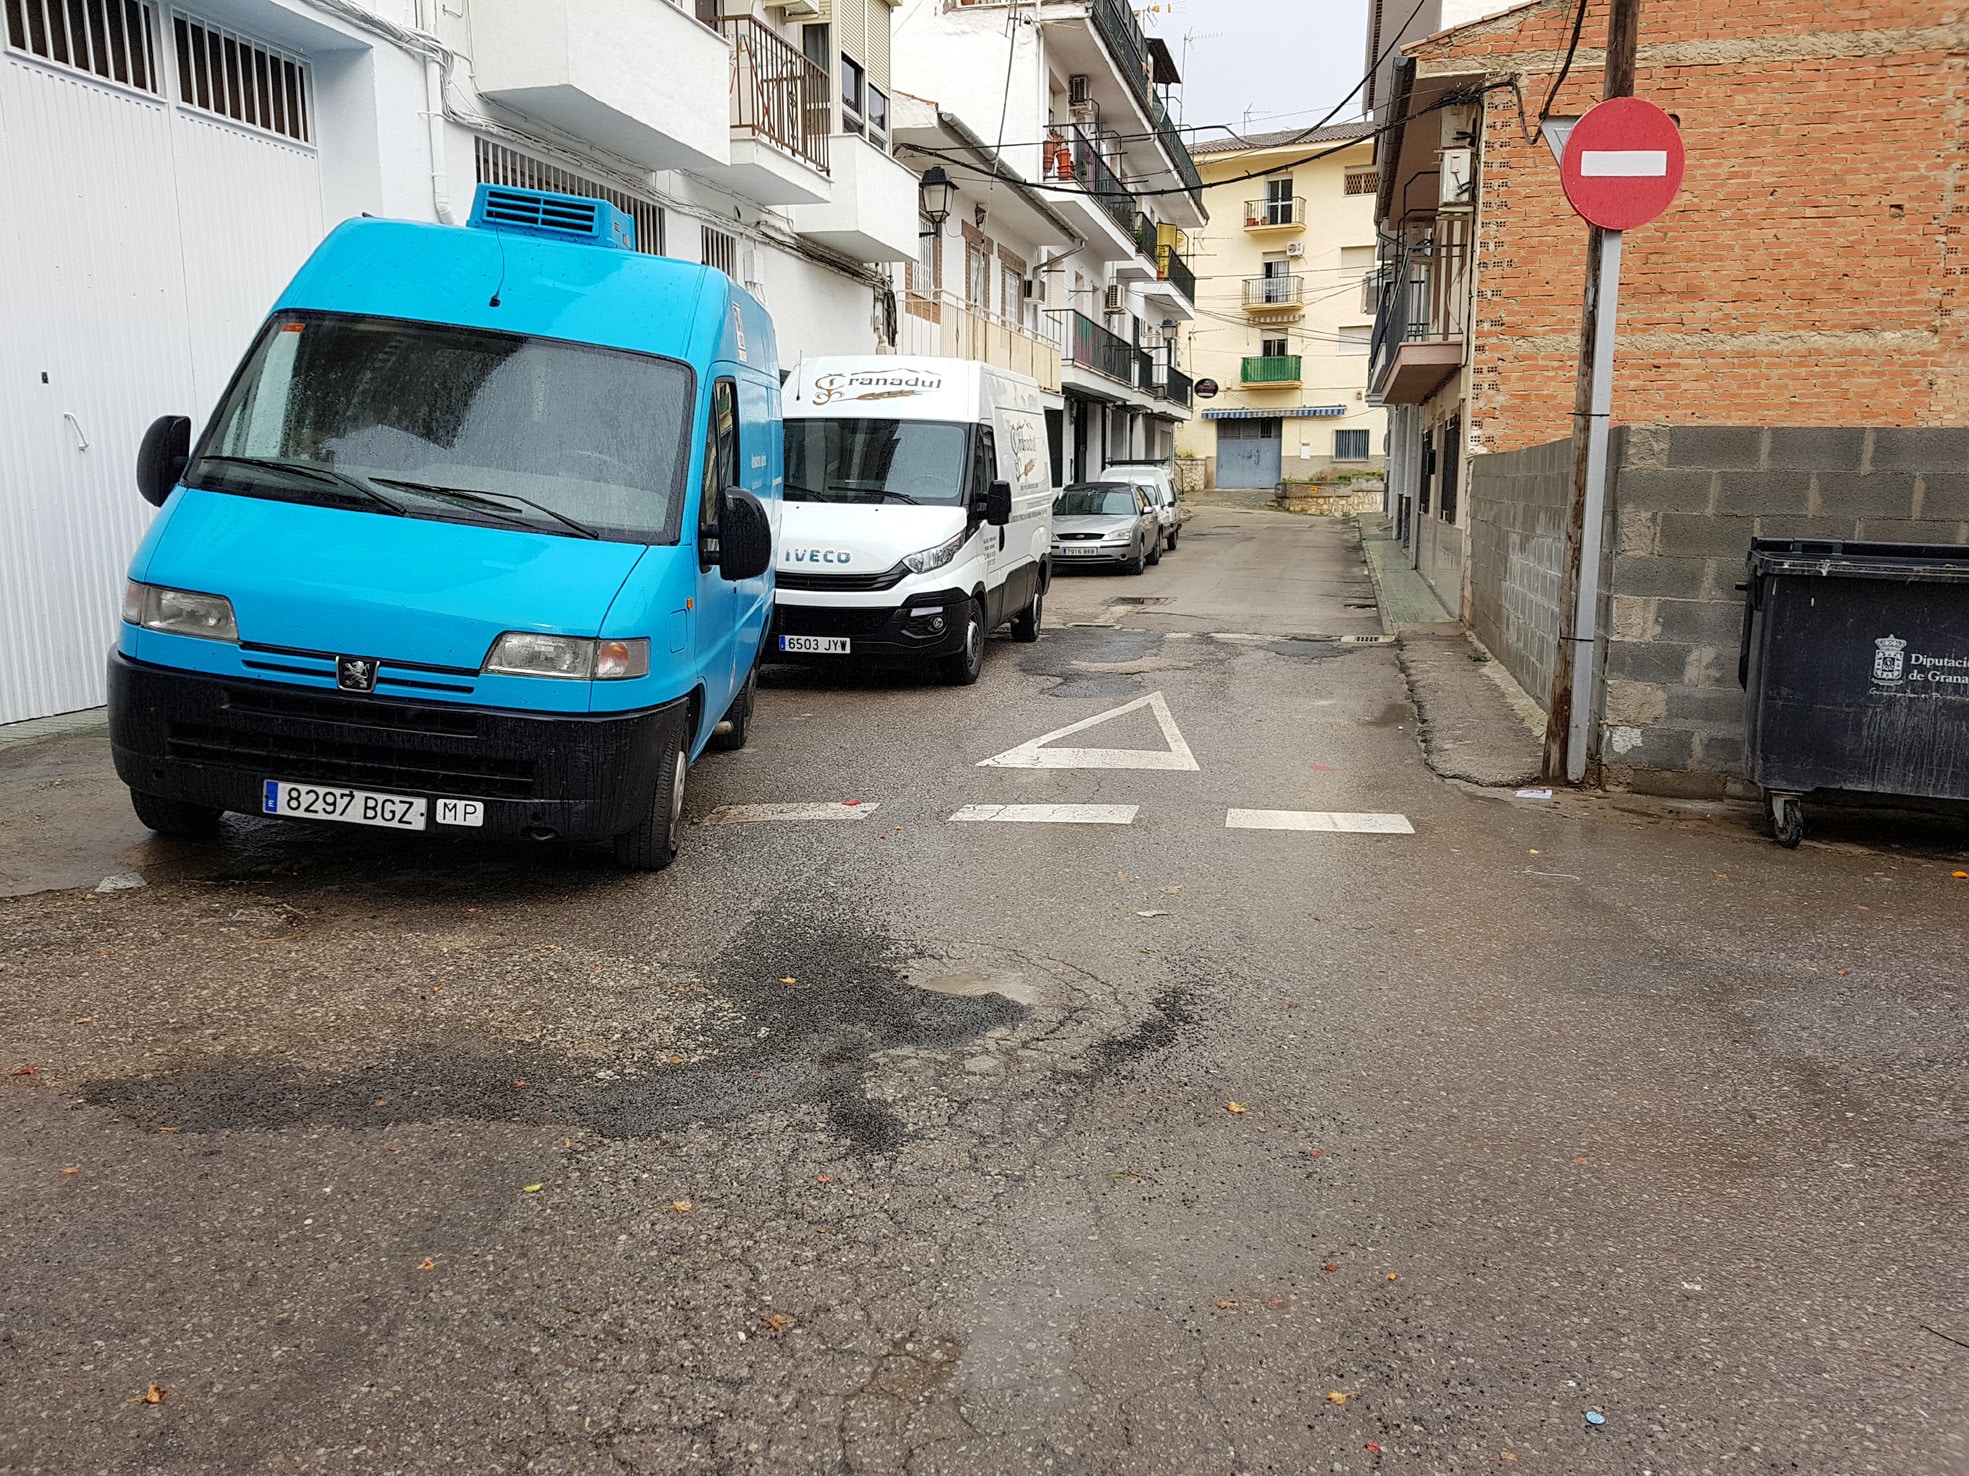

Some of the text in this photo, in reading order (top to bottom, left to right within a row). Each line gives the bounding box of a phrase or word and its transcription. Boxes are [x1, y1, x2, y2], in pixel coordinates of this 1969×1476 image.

[812, 373, 942, 406] Granadul
[785, 549, 851, 564] IVECO
[788, 637, 820, 651] 6503
[824, 639, 848, 652] JYW
[1908, 669, 1925, 681] de
[268, 800, 274, 808] E
[286, 787, 414, 825] 8297 BGZ
[443, 801, 478, 822] MP
